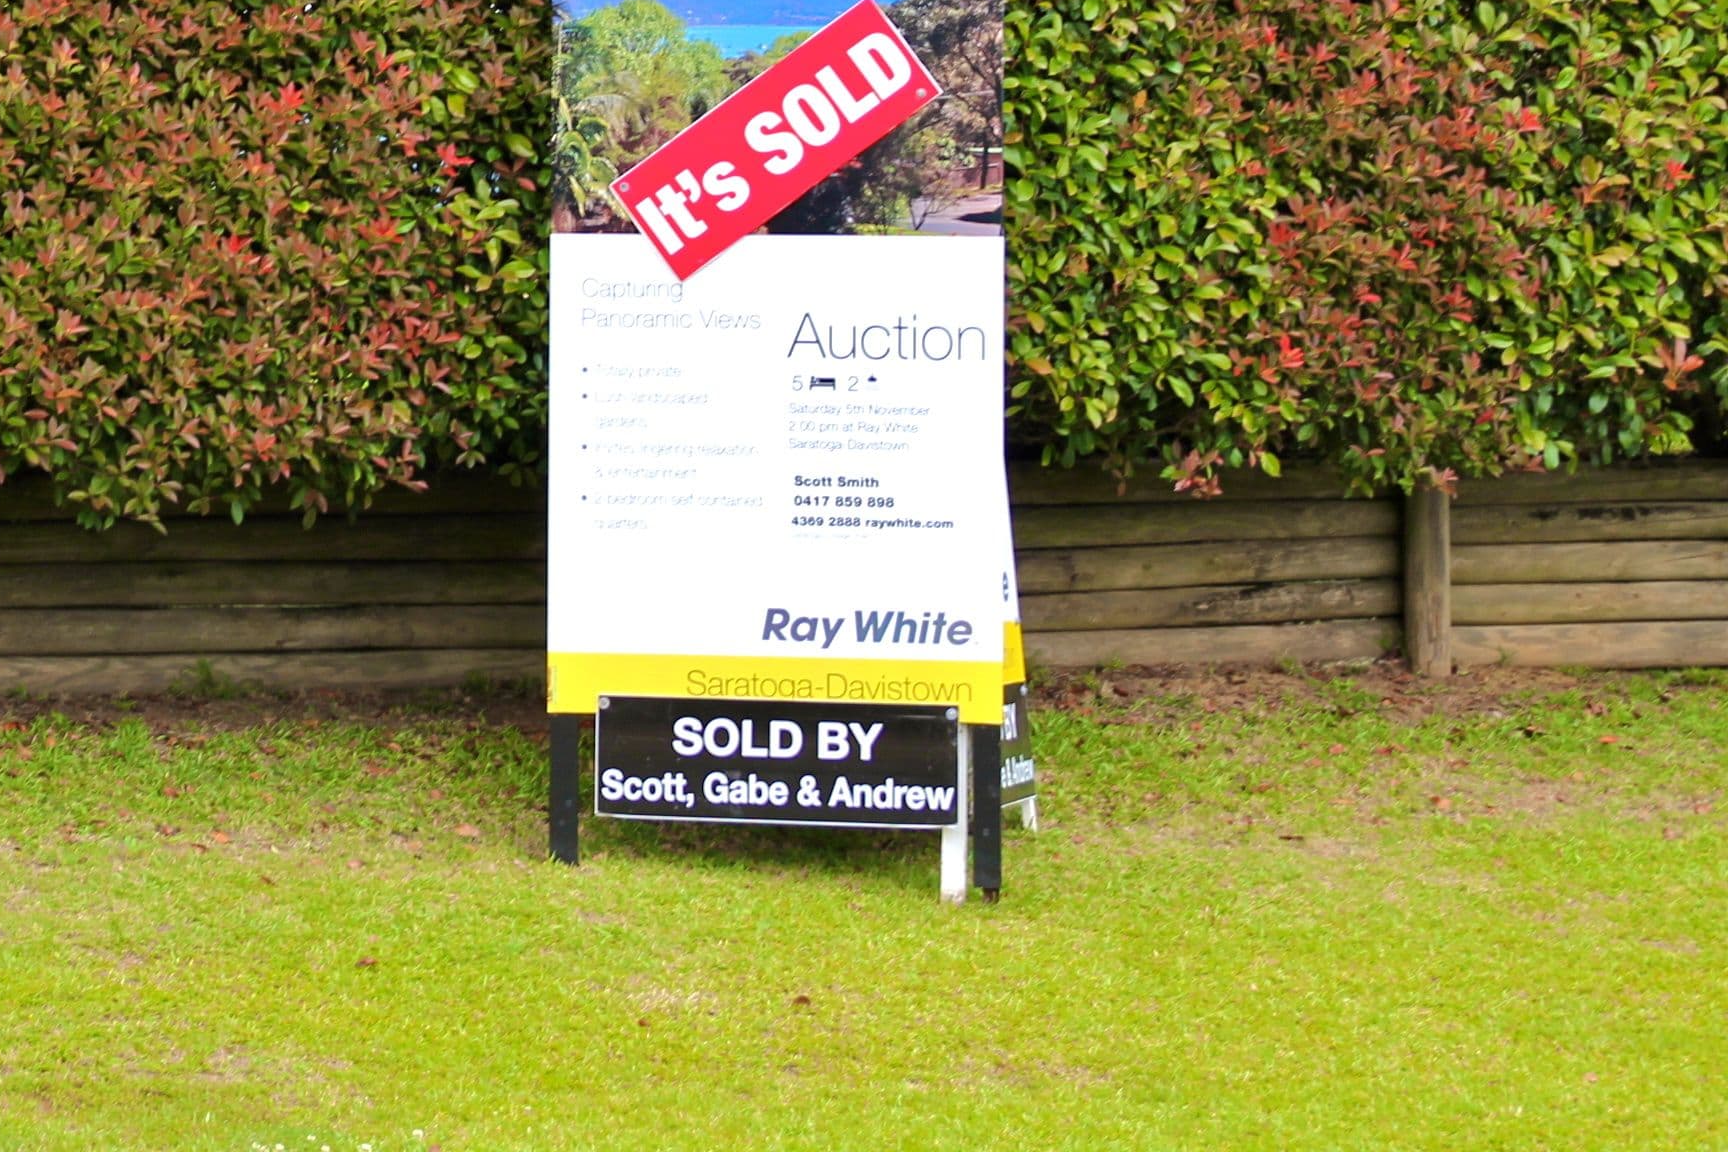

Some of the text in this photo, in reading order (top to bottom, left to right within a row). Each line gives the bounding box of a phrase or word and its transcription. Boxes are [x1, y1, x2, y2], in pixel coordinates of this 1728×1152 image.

[635, 32, 912, 256] It's SOLD
[582, 277, 684, 303] Capturing
[582, 308, 762, 329] Panoramic Views
[787, 312, 986, 361] Auction
[791, 375, 859, 391] 5 2
[857, 421, 880, 434] Ray
[794, 475, 879, 488] Scott Smith
[794, 495, 895, 508] 0417 859 898
[791, 516, 954, 530] 4369 2888 raywhite.com
[761, 608, 973, 648] Ray White
[686, 669, 974, 703] Saratoga-Davistown
[672, 716, 884, 761] SOLD BY
[600, 767, 955, 812] Scott, Gabe & Andrew
